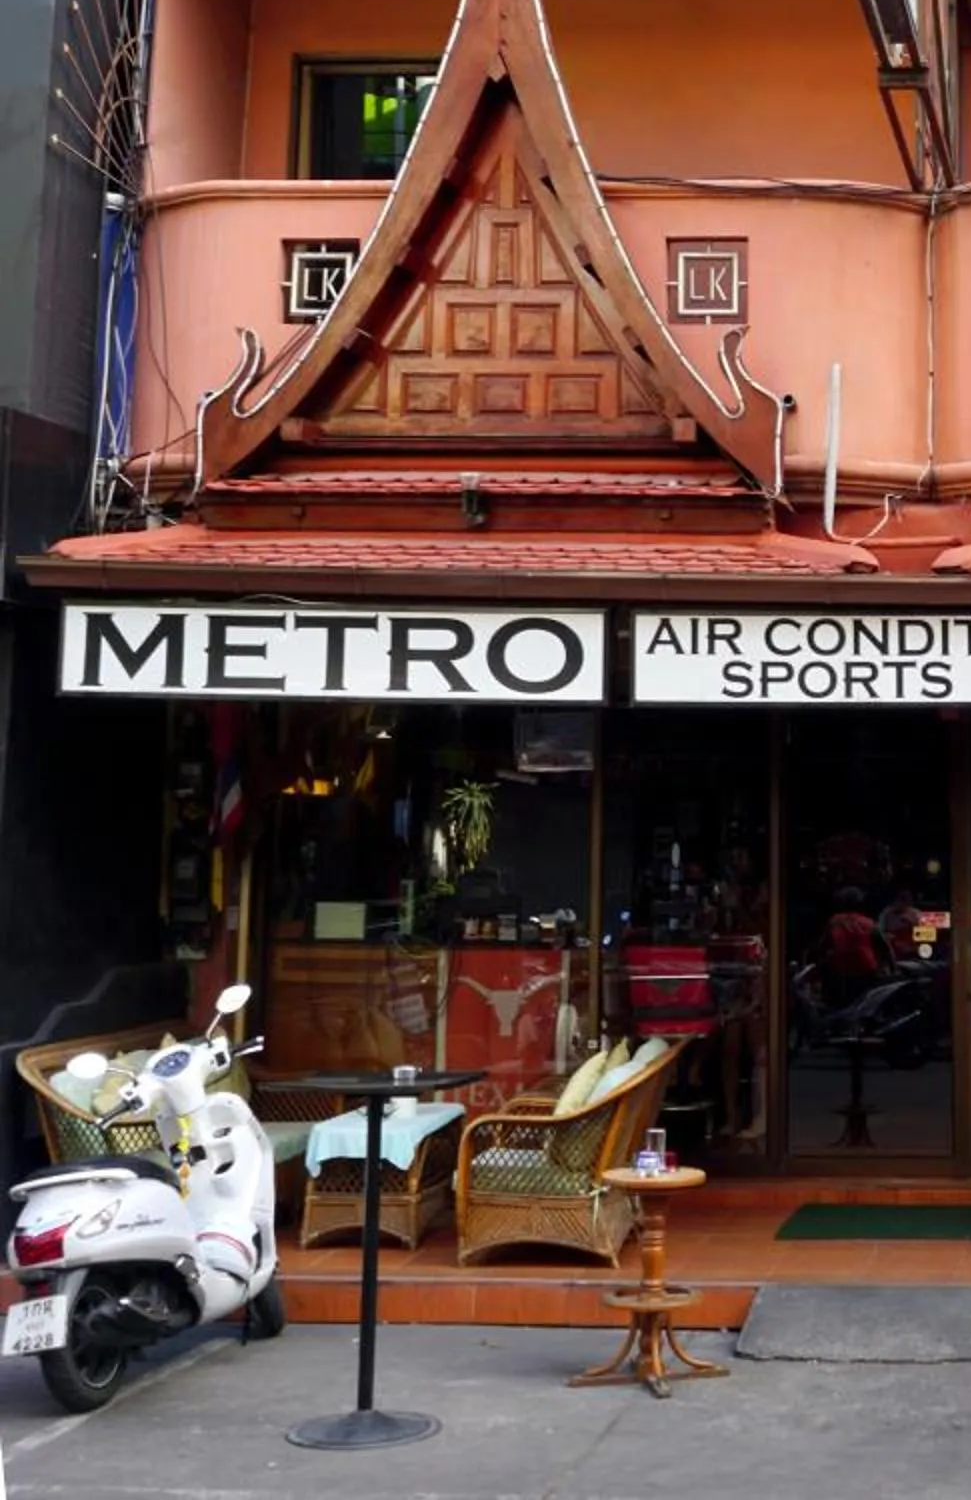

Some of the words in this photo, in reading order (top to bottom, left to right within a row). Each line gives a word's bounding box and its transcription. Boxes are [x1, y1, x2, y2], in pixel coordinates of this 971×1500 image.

[303, 266, 342, 301] LK
[690, 267, 727, 301] LK
[81, 612, 585, 694] METRO
[645, 616, 744, 656] AIR
[722, 661, 953, 699] SPORTS
